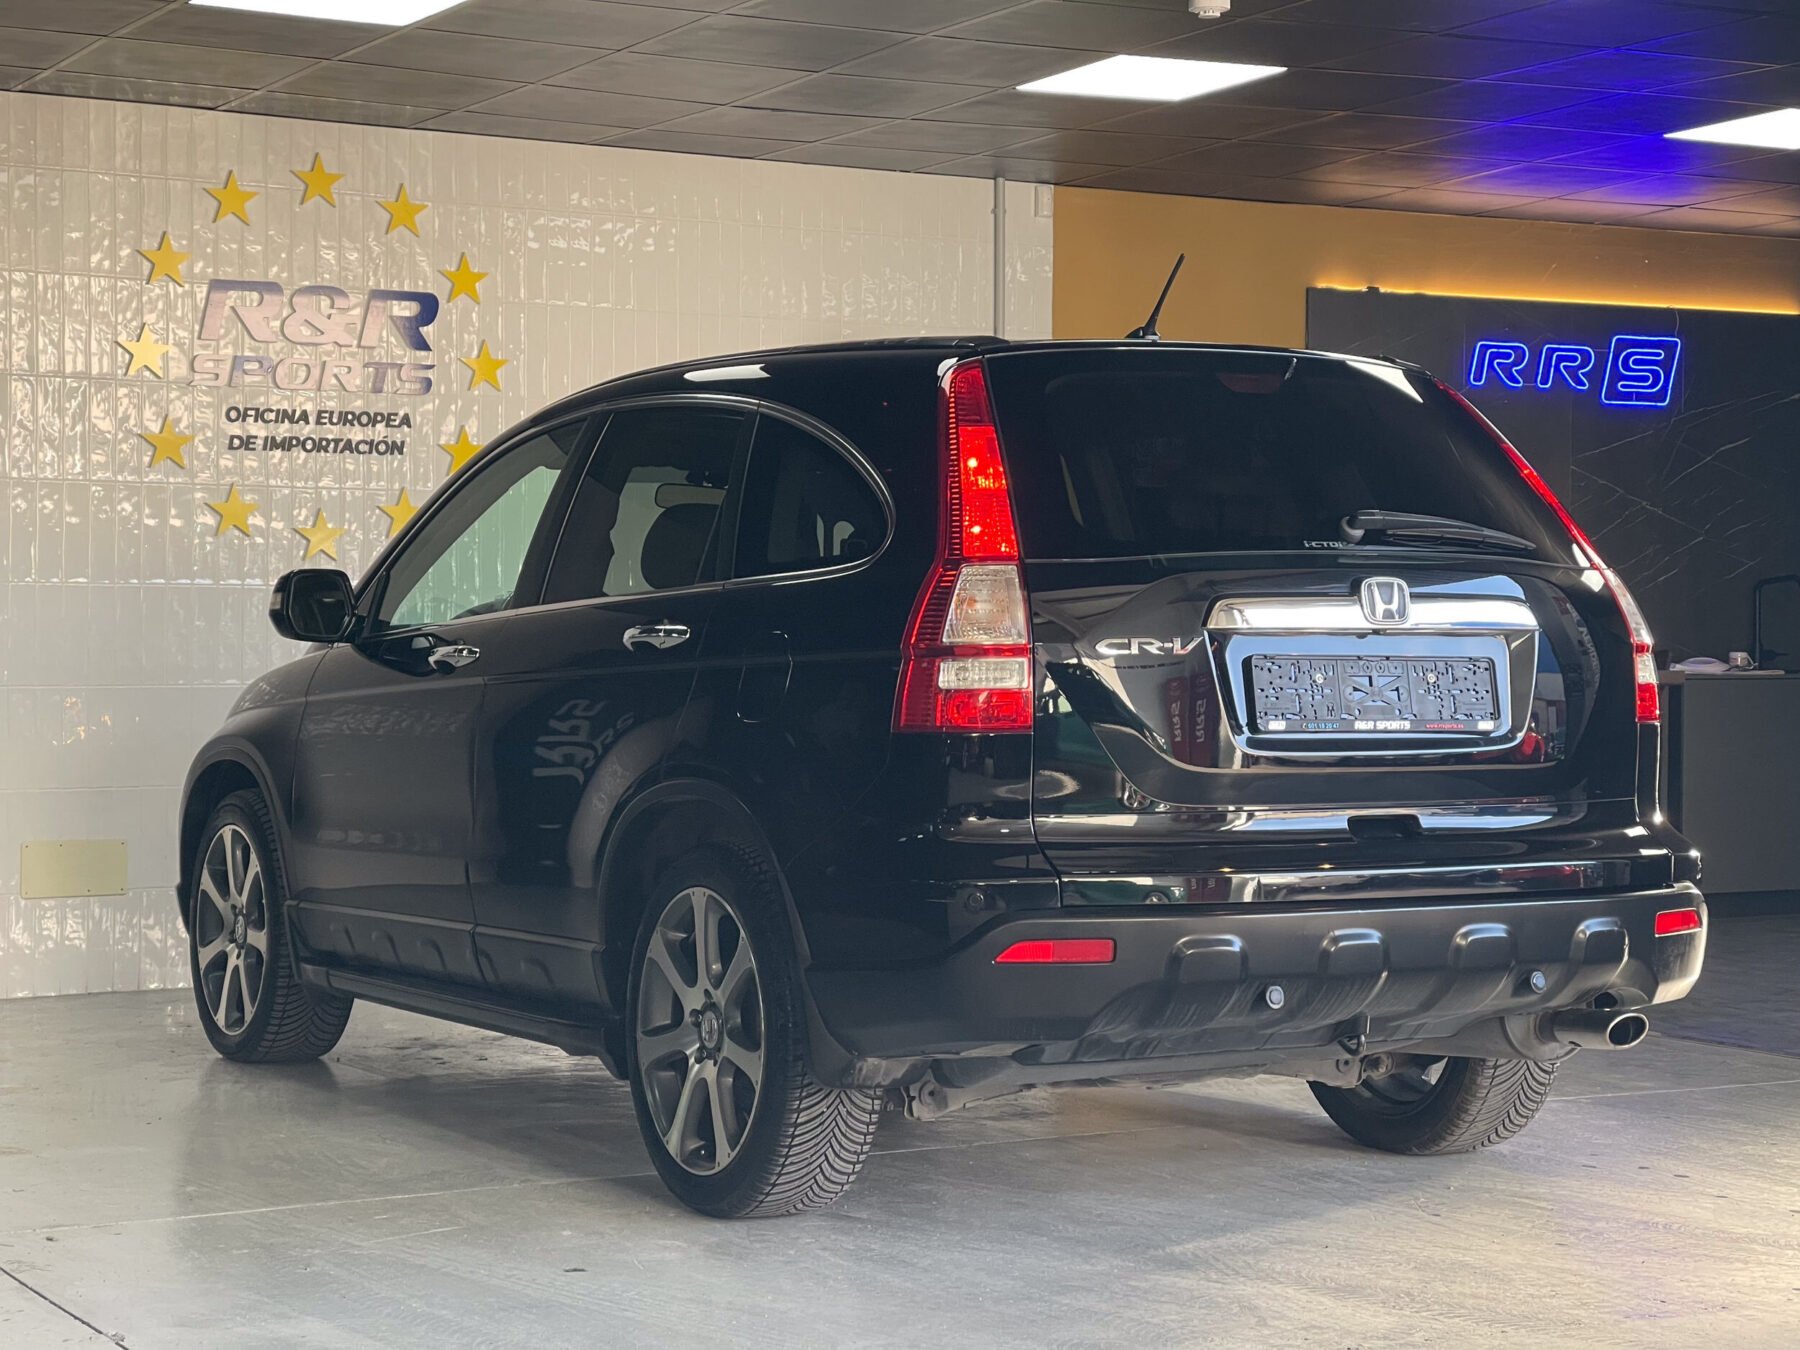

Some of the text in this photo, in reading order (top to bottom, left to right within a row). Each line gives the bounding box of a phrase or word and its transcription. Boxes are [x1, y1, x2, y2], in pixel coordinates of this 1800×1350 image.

[199, 278, 440, 352] R&R
[189, 353, 436, 396] SPORTS
[225, 406, 412, 429] OFICINA EUROPEA
[228, 434, 406, 456] DE IMPORTACIÓN
[1095, 637, 1204, 655] CR-V
[1375, 721, 1411, 730] SPORTS
